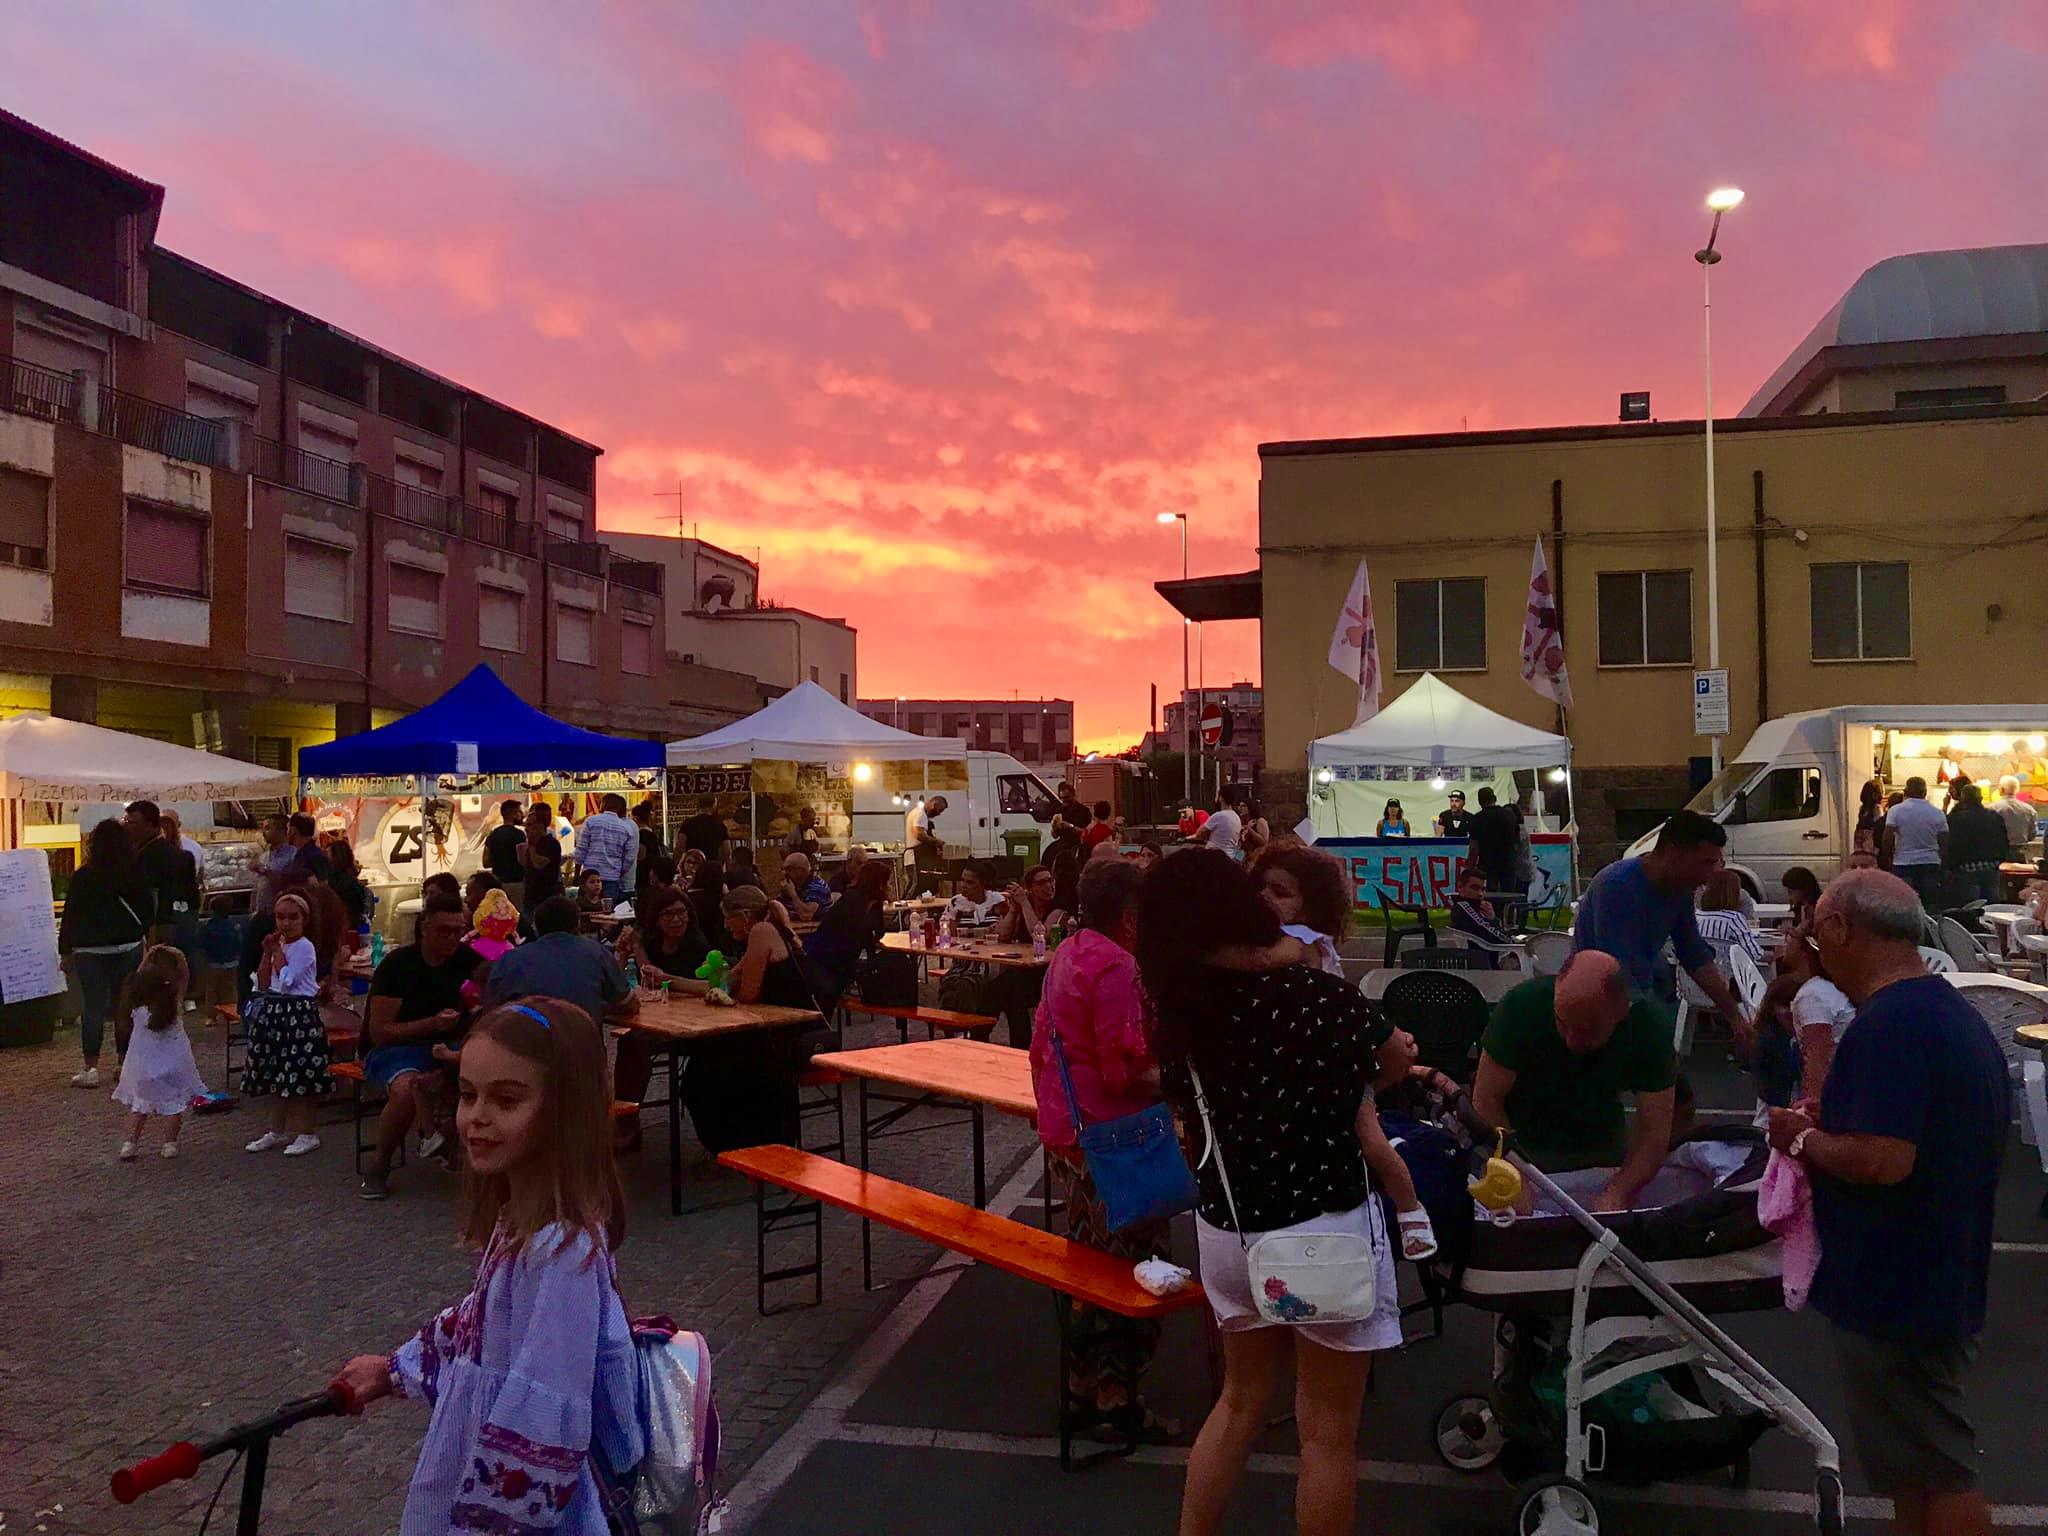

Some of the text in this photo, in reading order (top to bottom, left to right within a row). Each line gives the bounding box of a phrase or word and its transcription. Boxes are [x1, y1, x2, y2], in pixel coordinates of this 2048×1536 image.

[1699, 680, 1708, 692] P
[19, 776, 88, 800] Pizzeria
[319, 777, 369, 793] CALAMARI
[371, 776, 400, 792] FRITTI
[467, 773, 555, 790] FRITTURA
[581, 771, 630, 788] MARE
